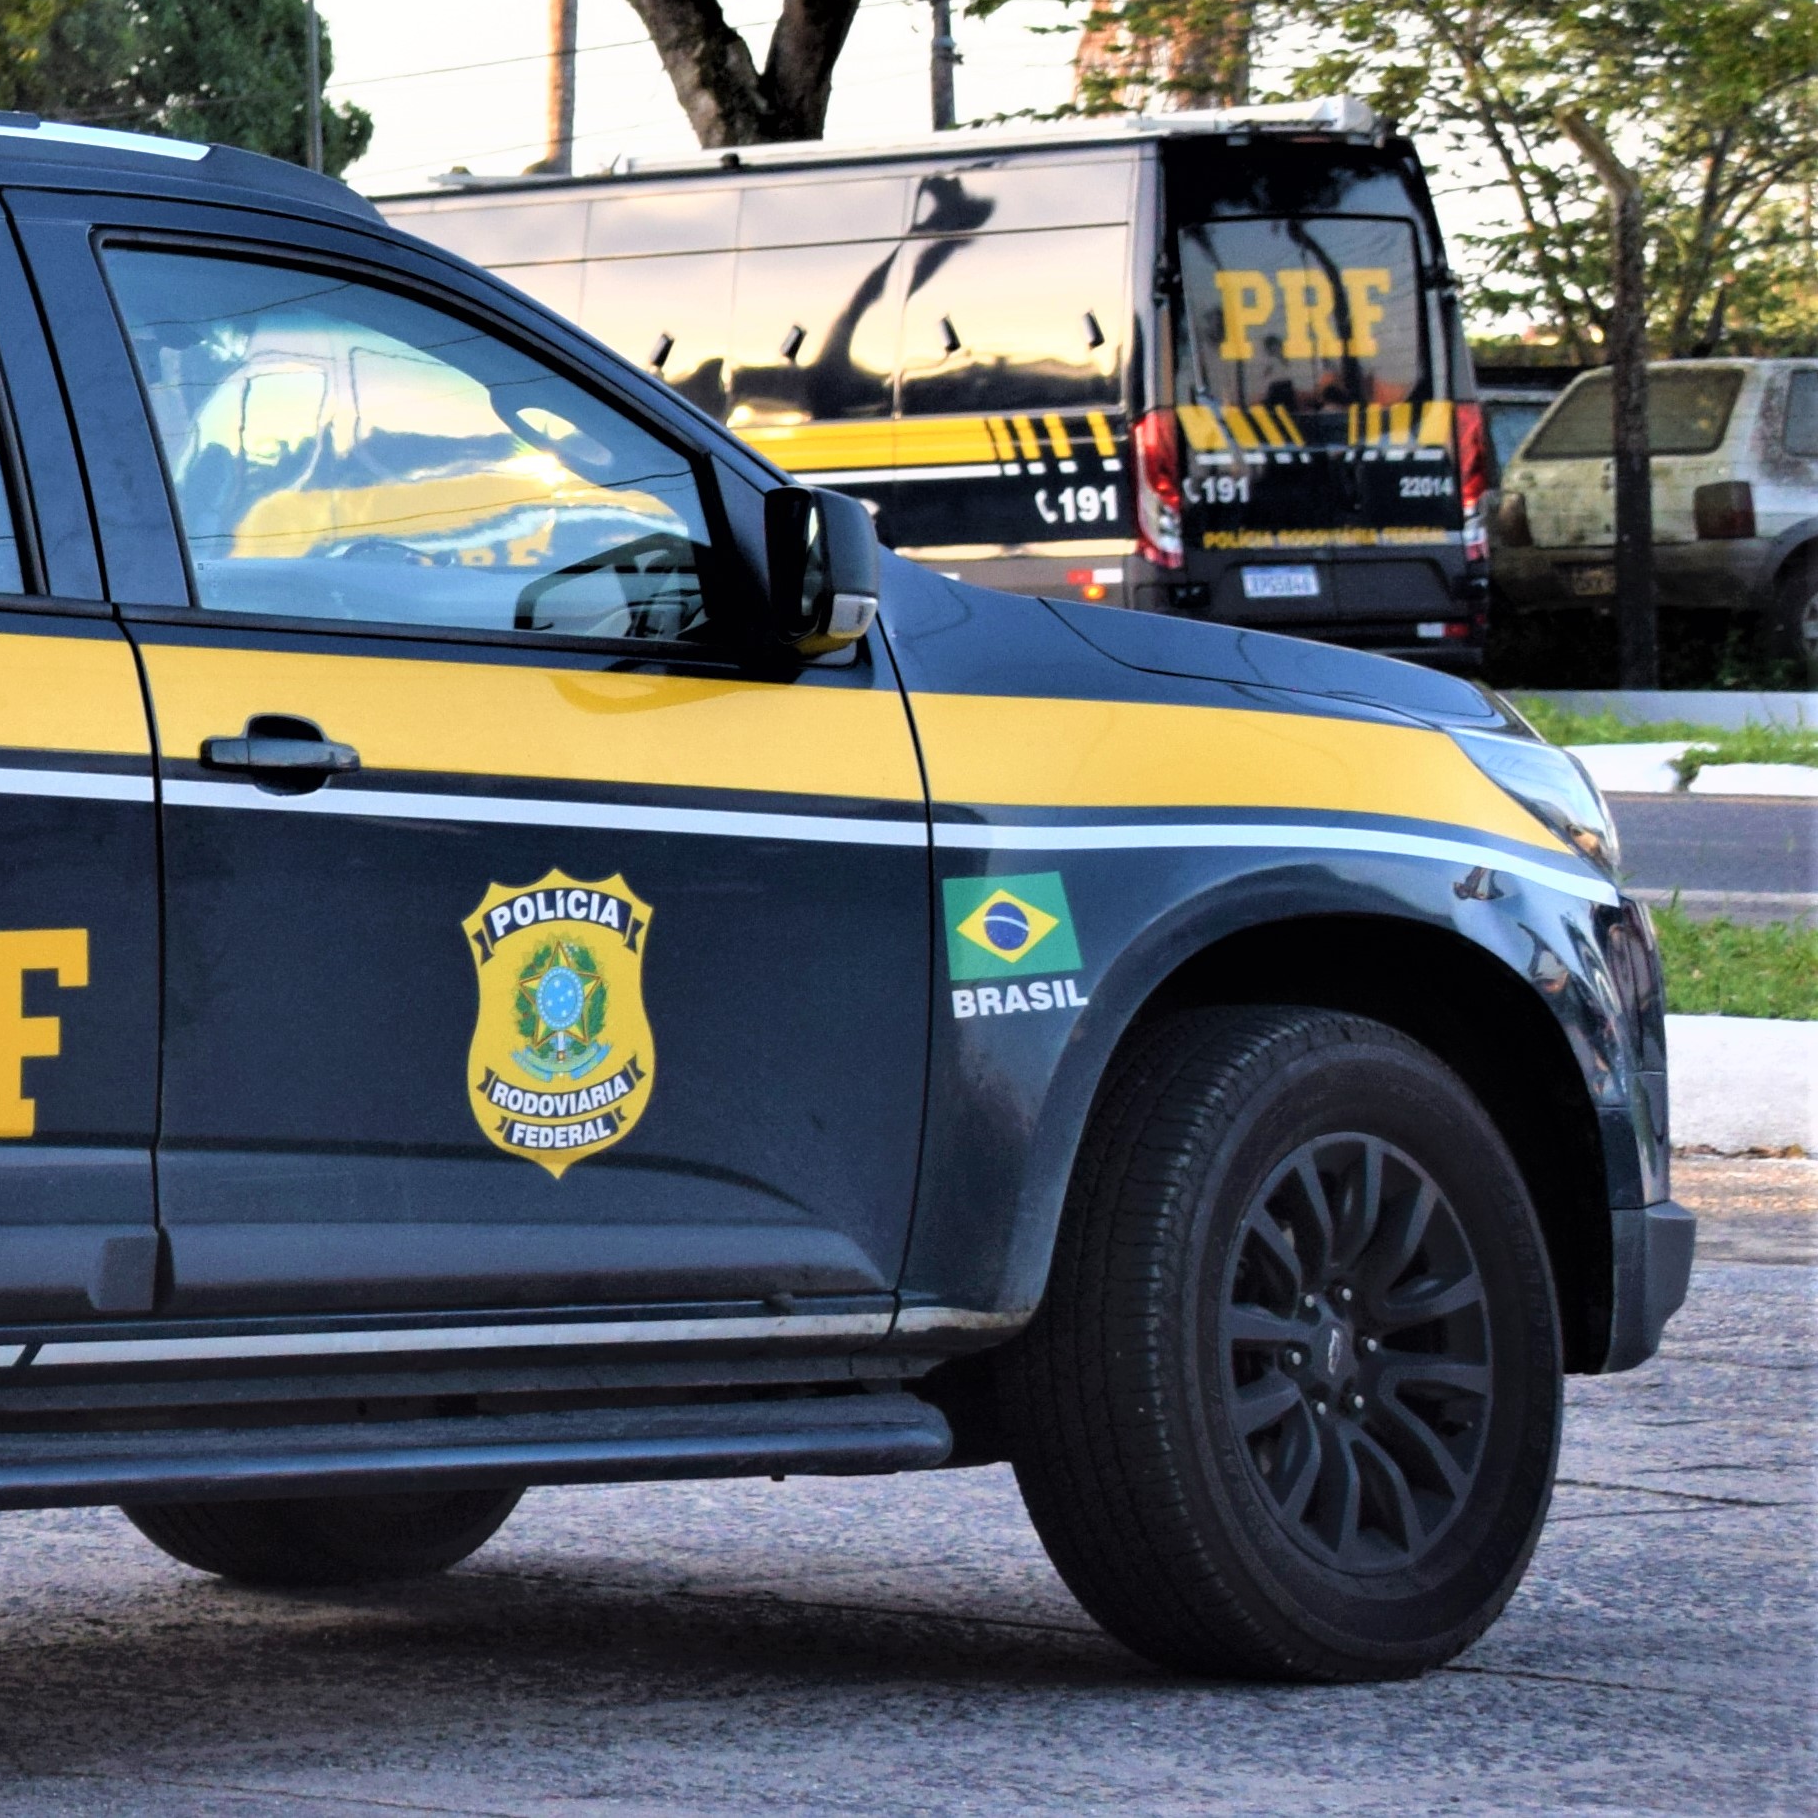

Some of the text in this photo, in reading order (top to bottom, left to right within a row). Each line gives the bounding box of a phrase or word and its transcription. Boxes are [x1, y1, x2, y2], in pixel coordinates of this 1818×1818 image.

[1215, 268, 1391, 360] PRF
[1058, 485, 1119, 523] 191
[1201, 476, 1251, 504] 191
[490, 889, 621, 937] POLÍCIA
[951, 979, 1089, 1019] BRASIL
[491, 1075, 630, 1117] RODOVIÁRIA
[511, 1117, 612, 1148] FEDERAL
